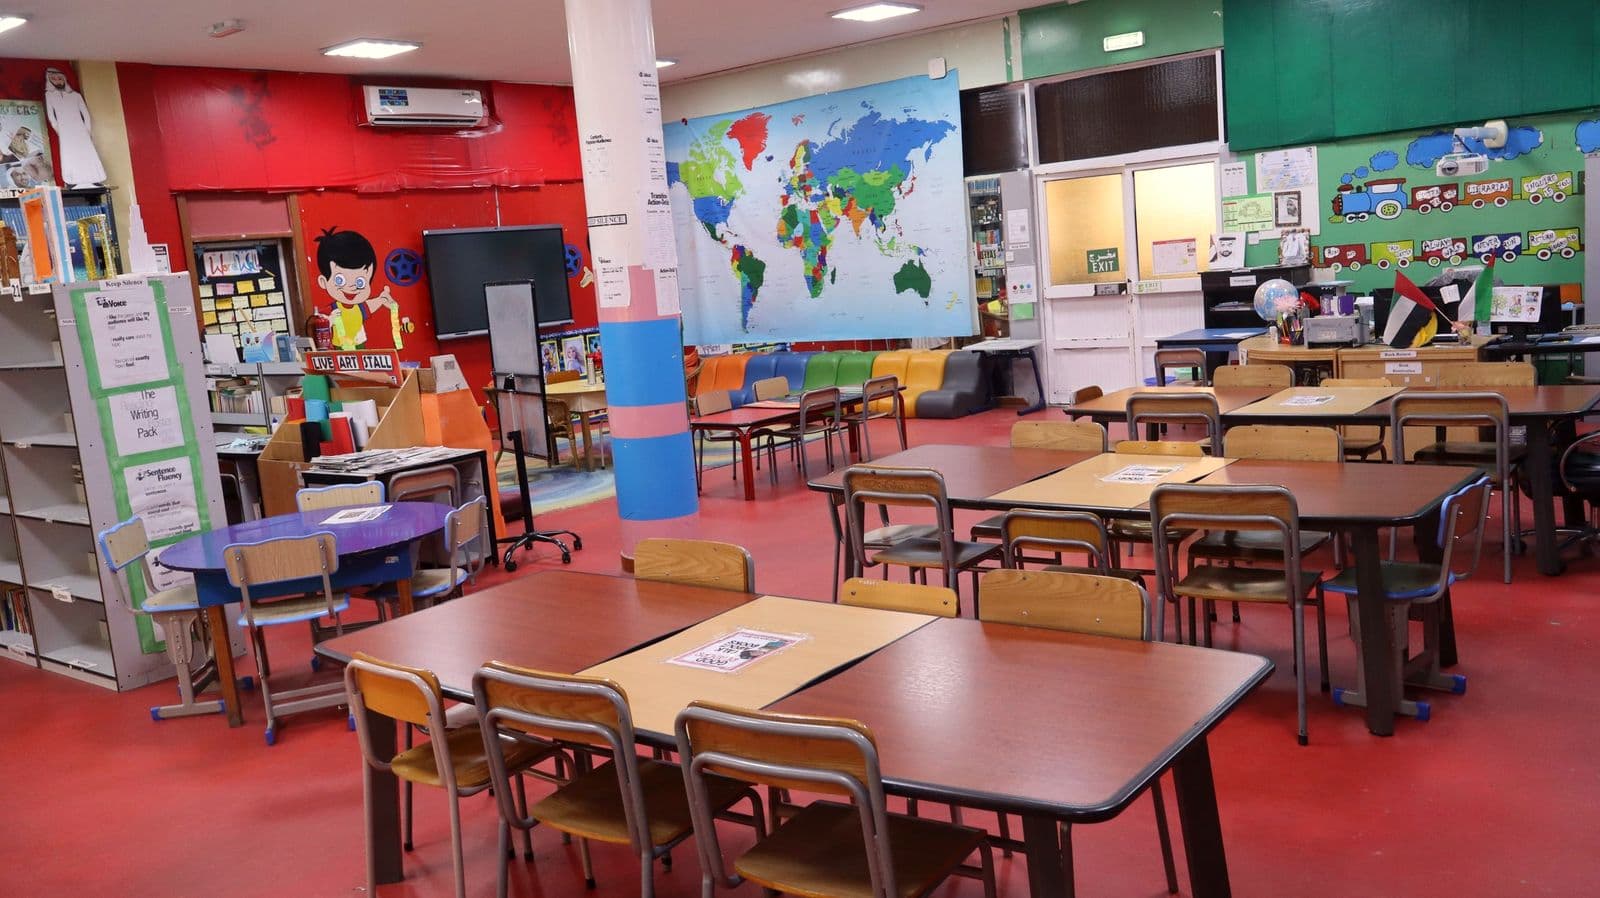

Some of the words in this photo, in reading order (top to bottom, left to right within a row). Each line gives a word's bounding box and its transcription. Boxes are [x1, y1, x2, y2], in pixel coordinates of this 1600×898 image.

[597, 216, 625, 224] SILENCE
[1477, 237, 1499, 249] NEVER
[1093, 261, 1114, 272] EXIT
[313, 357, 334, 369] LIVE
[339, 356, 357, 369] ART
[363, 355, 391, 369] STALL
[130, 408, 159, 420] Writing
[137, 426, 158, 438] Pack
[146, 467, 176, 477] Sentence
[157, 473, 182, 481] Fluency
